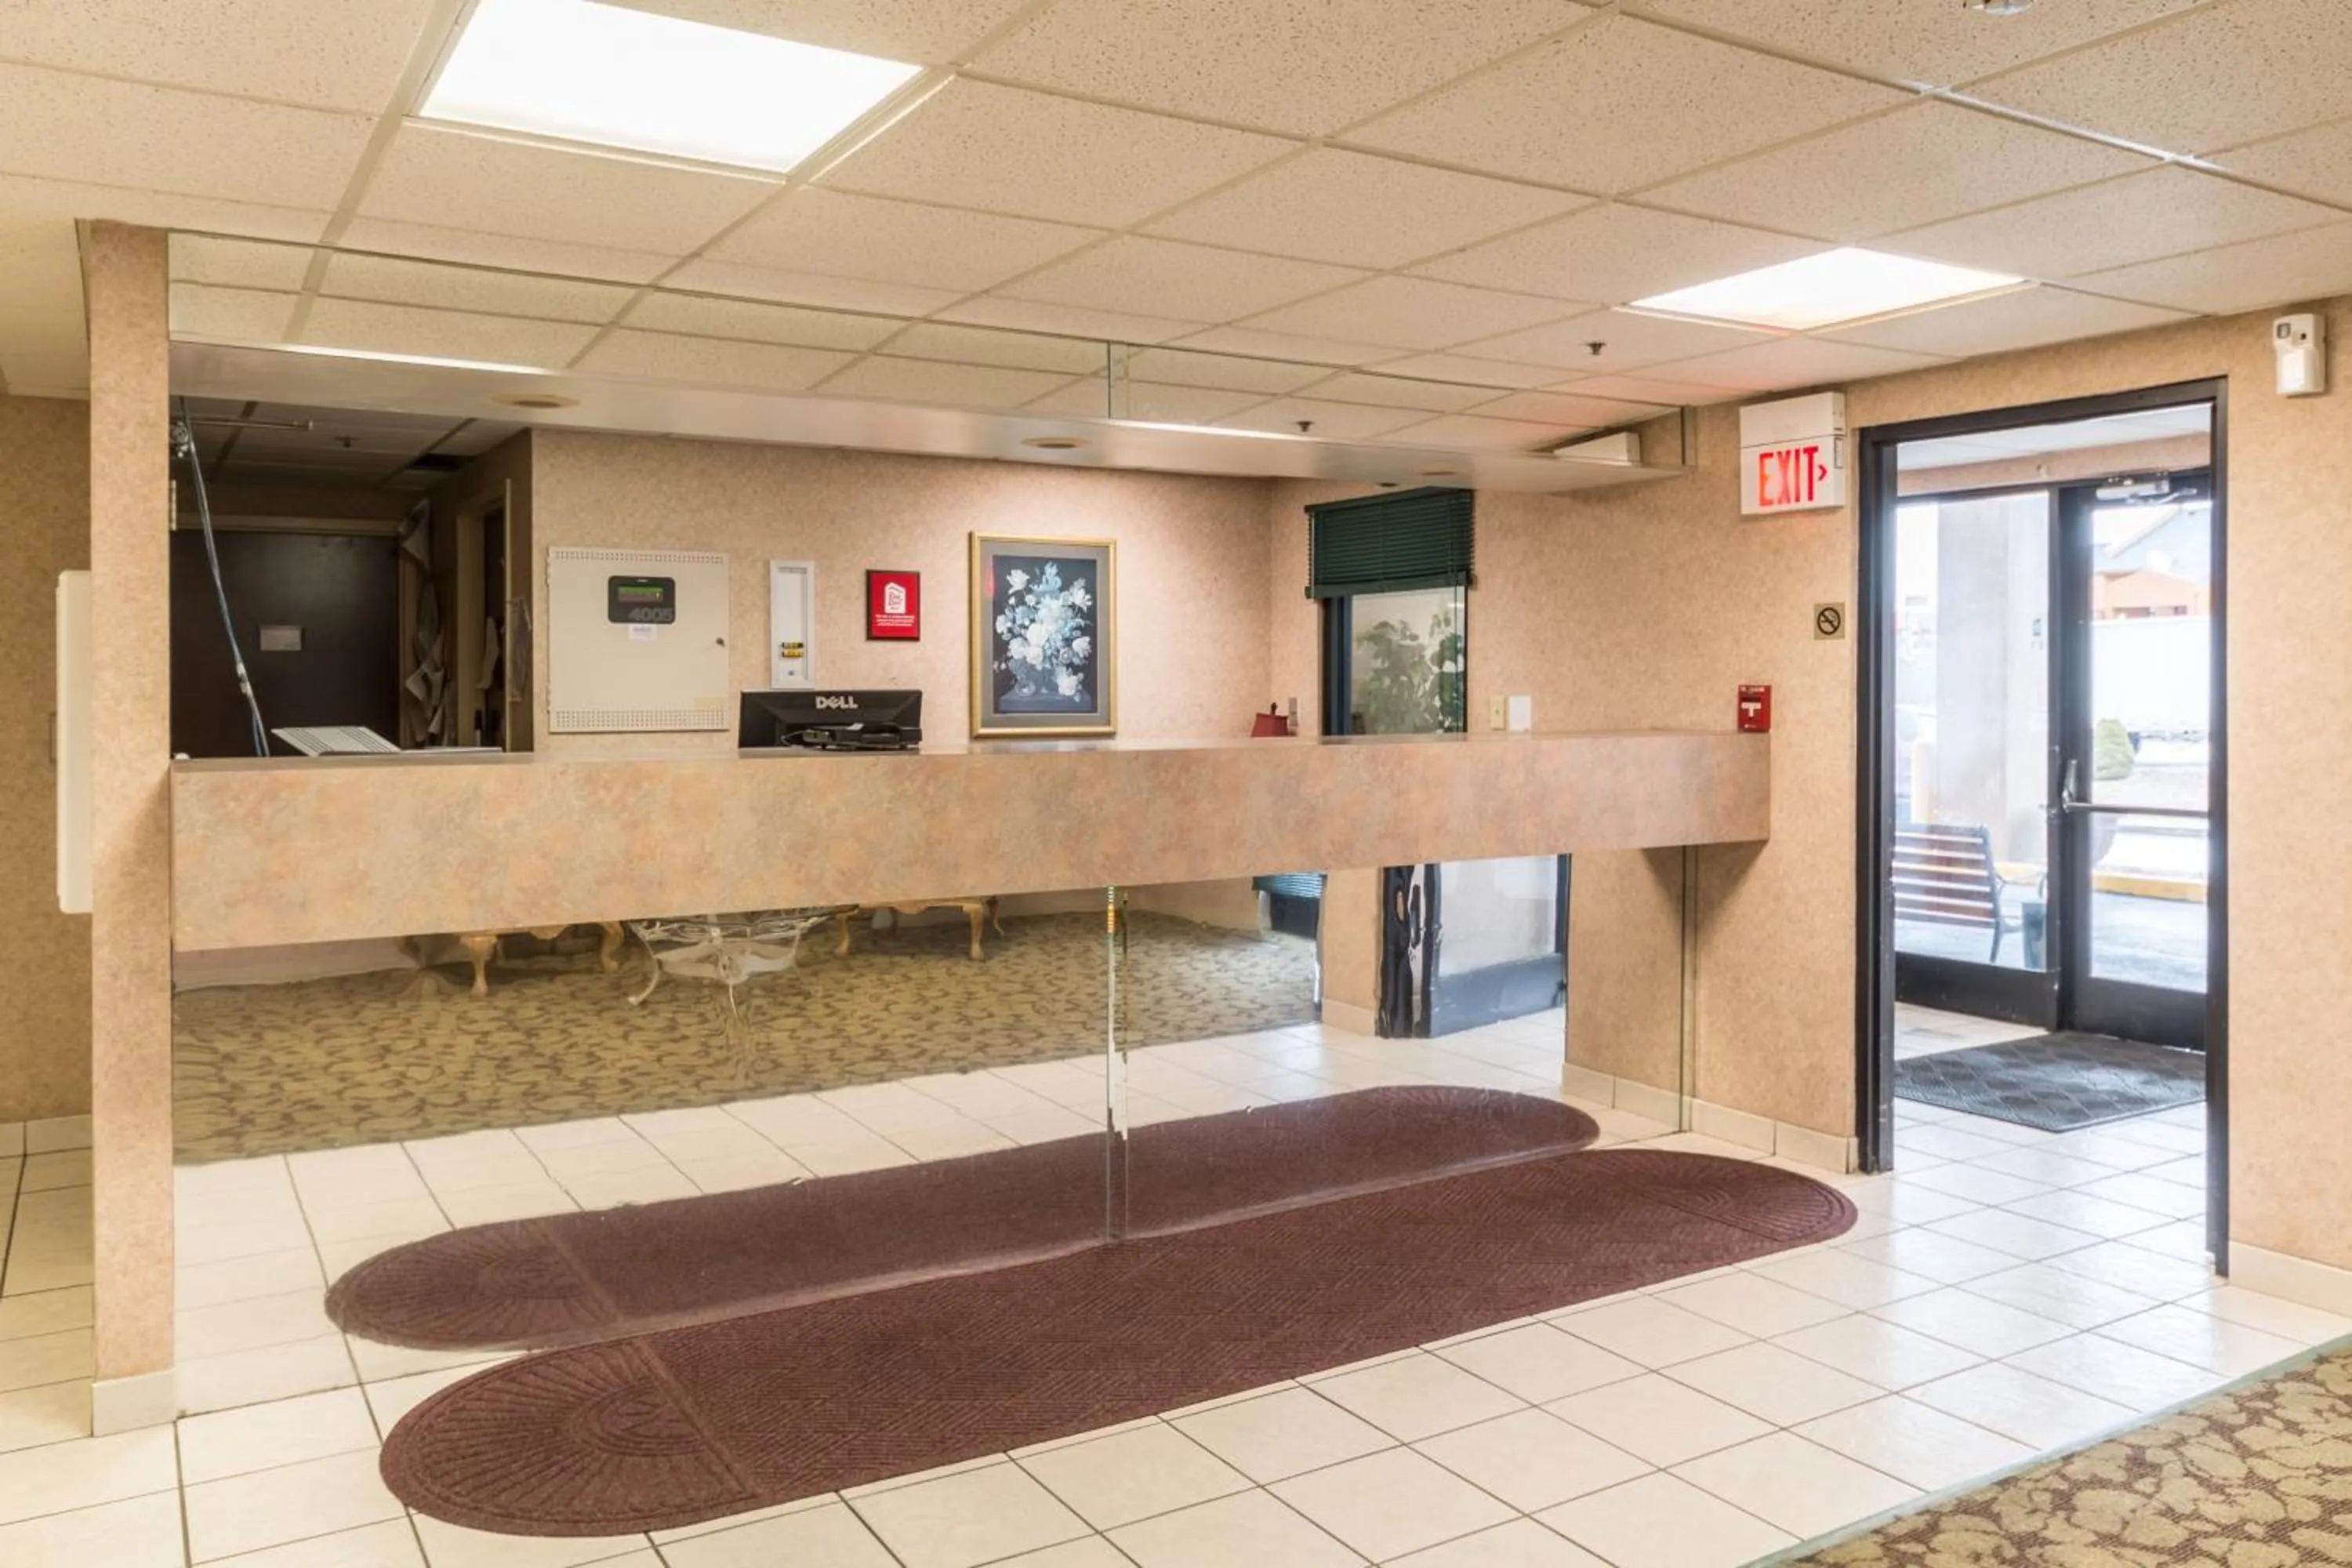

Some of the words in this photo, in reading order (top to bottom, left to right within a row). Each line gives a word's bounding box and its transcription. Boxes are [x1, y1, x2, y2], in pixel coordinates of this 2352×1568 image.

[1758, 445, 1820, 507] EXIT
[628, 608, 673, 622] 4005
[815, 695, 858, 710] DELL
